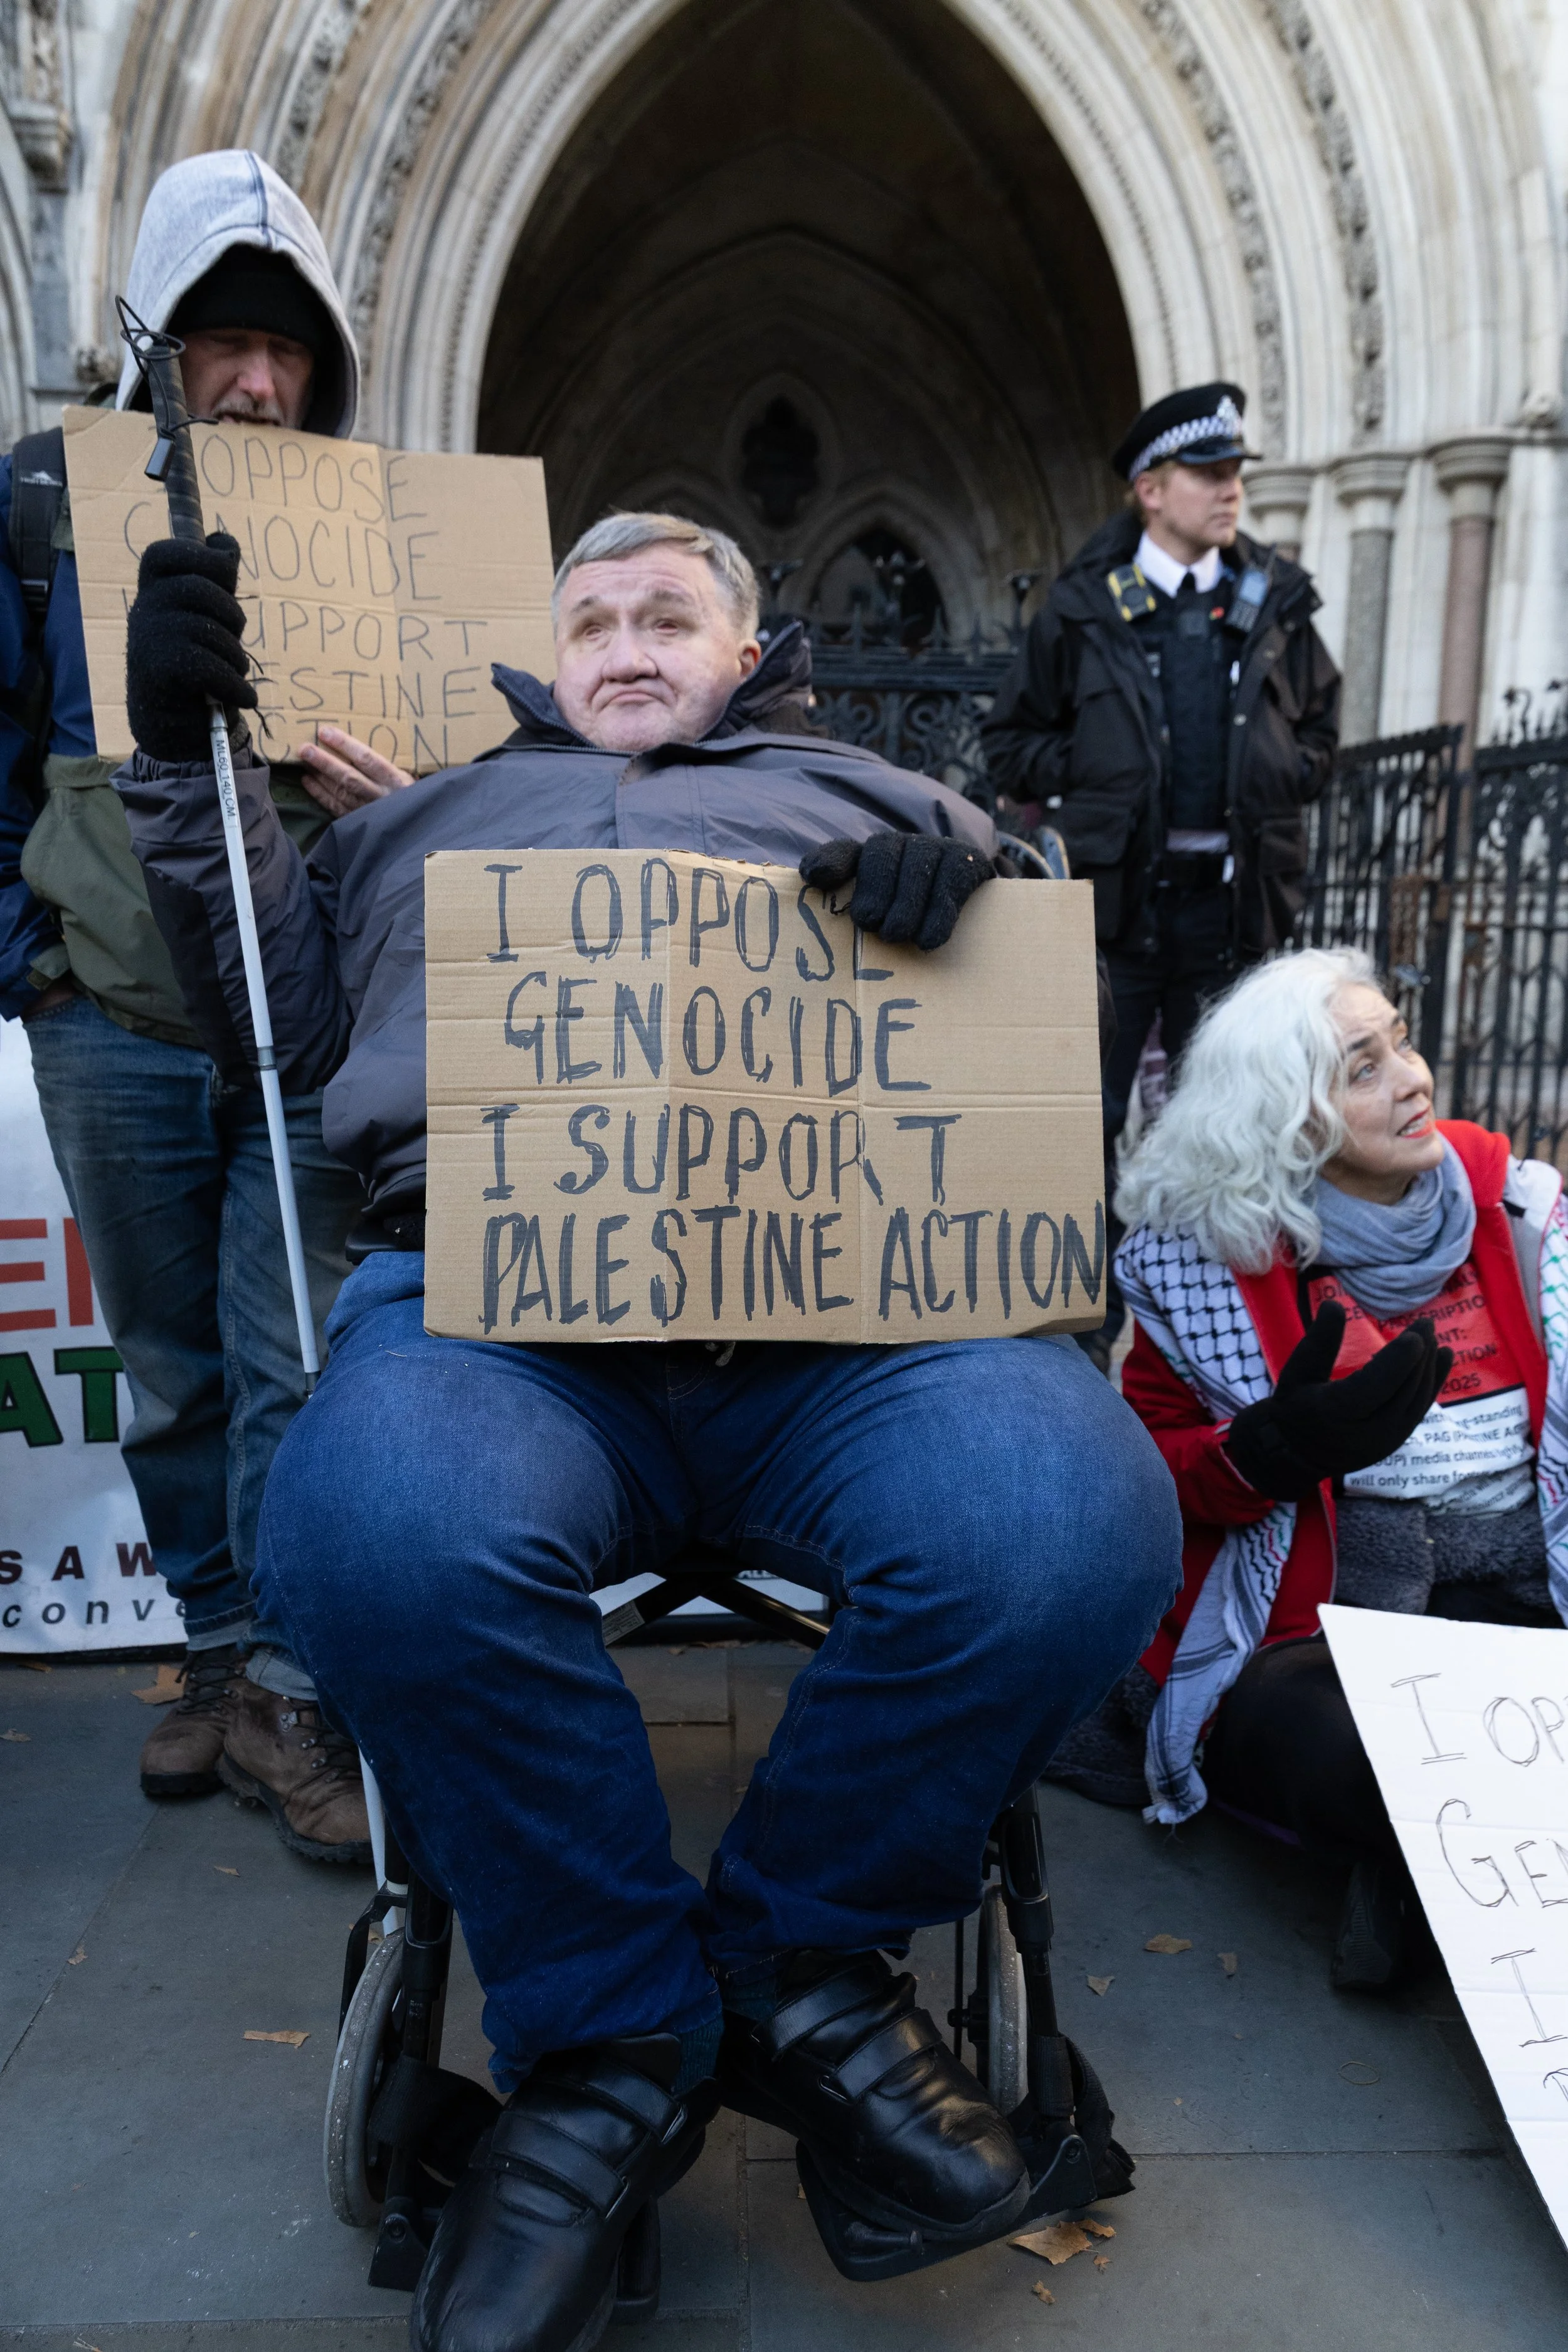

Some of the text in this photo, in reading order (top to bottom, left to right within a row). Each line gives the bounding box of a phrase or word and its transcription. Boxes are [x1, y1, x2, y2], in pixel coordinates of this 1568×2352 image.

[201, 433, 427, 524] OPPOSE
[240, 598, 487, 661] UPPORT
[484, 864, 522, 963] I
[504, 970, 932, 1098] GENOCIDE
[480, 1103, 962, 1205] I SUPPORT
[479, 1199, 1106, 1335] PALESTINE ACTION
[1378, 1475, 1409, 1490] only
[1412, 1473, 1450, 1486] share
[1411, 1451, 1451, 1466] media
[1483, 1695, 1568, 1767] OP
